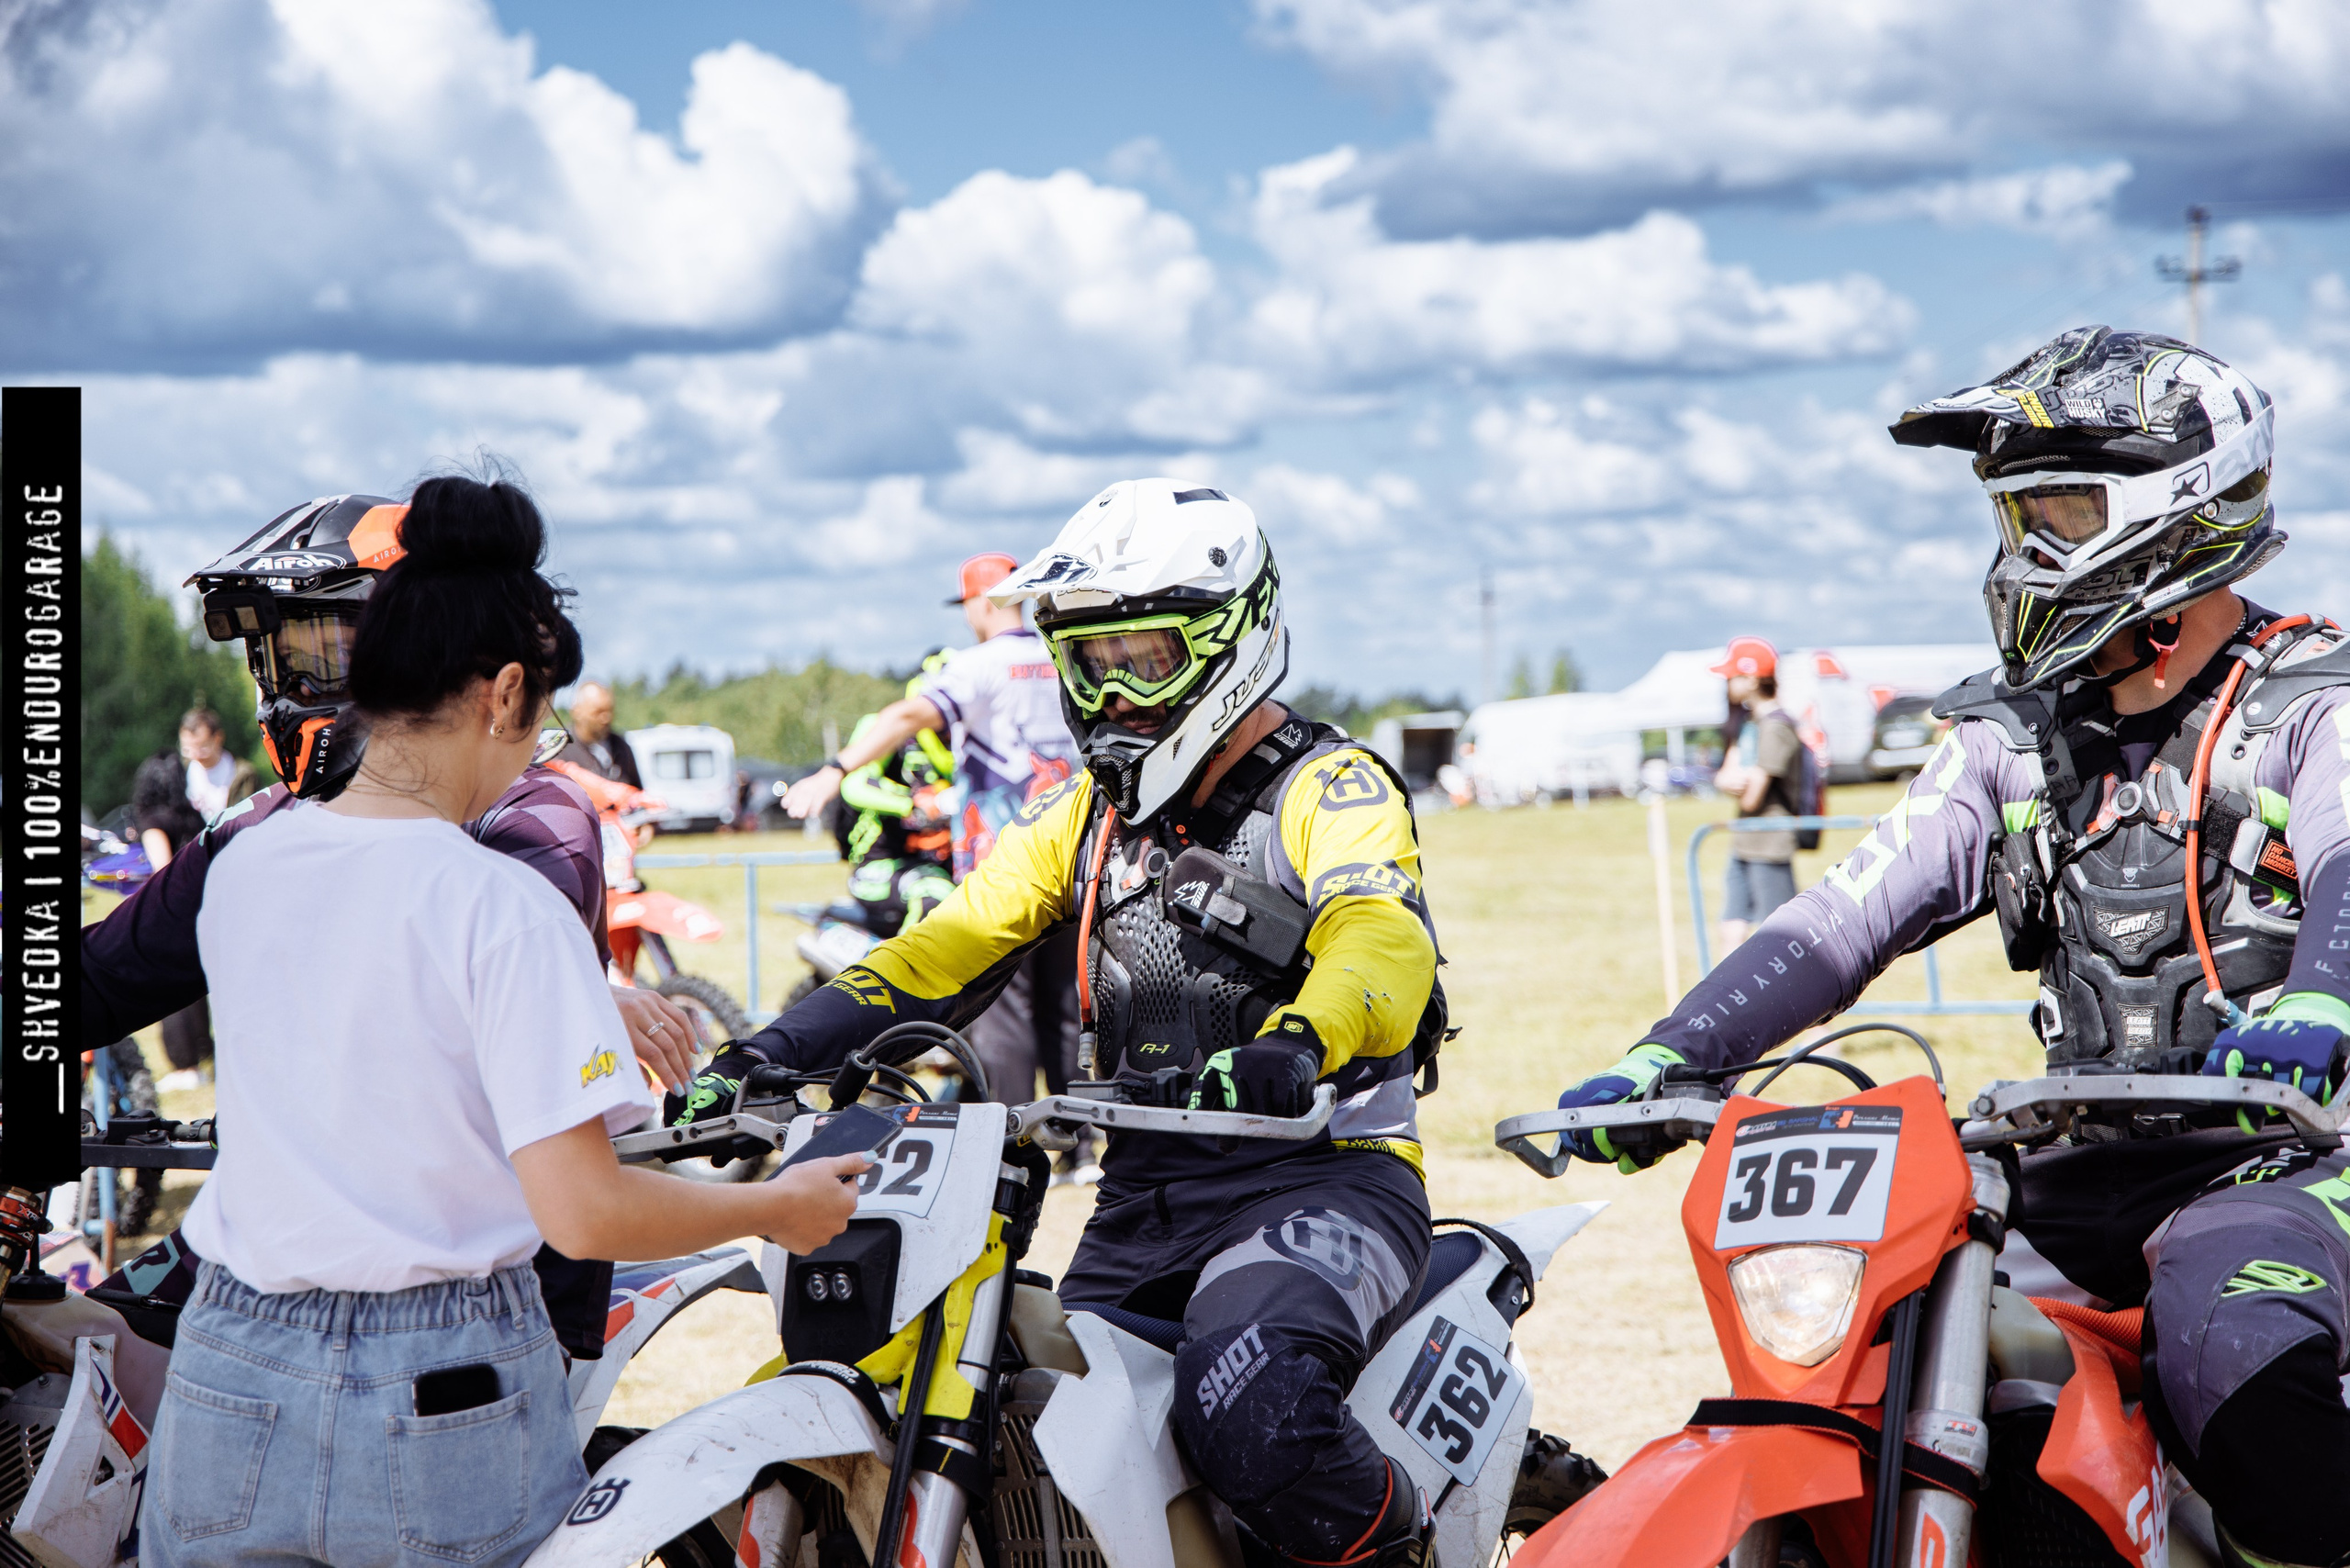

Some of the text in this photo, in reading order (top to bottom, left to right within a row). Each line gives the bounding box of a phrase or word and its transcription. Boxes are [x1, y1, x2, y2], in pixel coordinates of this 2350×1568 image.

[2066, 399, 2092, 409] WILD
[2068, 408, 2106, 420] HUSKY
[248, 554, 336, 571] Airoh
[315, 728, 331, 774] AIROH
[2267, 852, 2296, 868] DANCIN
[2271, 845, 2284, 856] NO
[2265, 857, 2297, 875] MONKEY
[2109, 913, 2152, 938] LEATT
[856, 1138, 934, 1196] 62
[1728, 1147, 1878, 1224] 367
[1196, 1323, 1265, 1421] SHOT
[1222, 1351, 1270, 1410] RACE GEAR
[1416, 1345, 1508, 1464] 362
